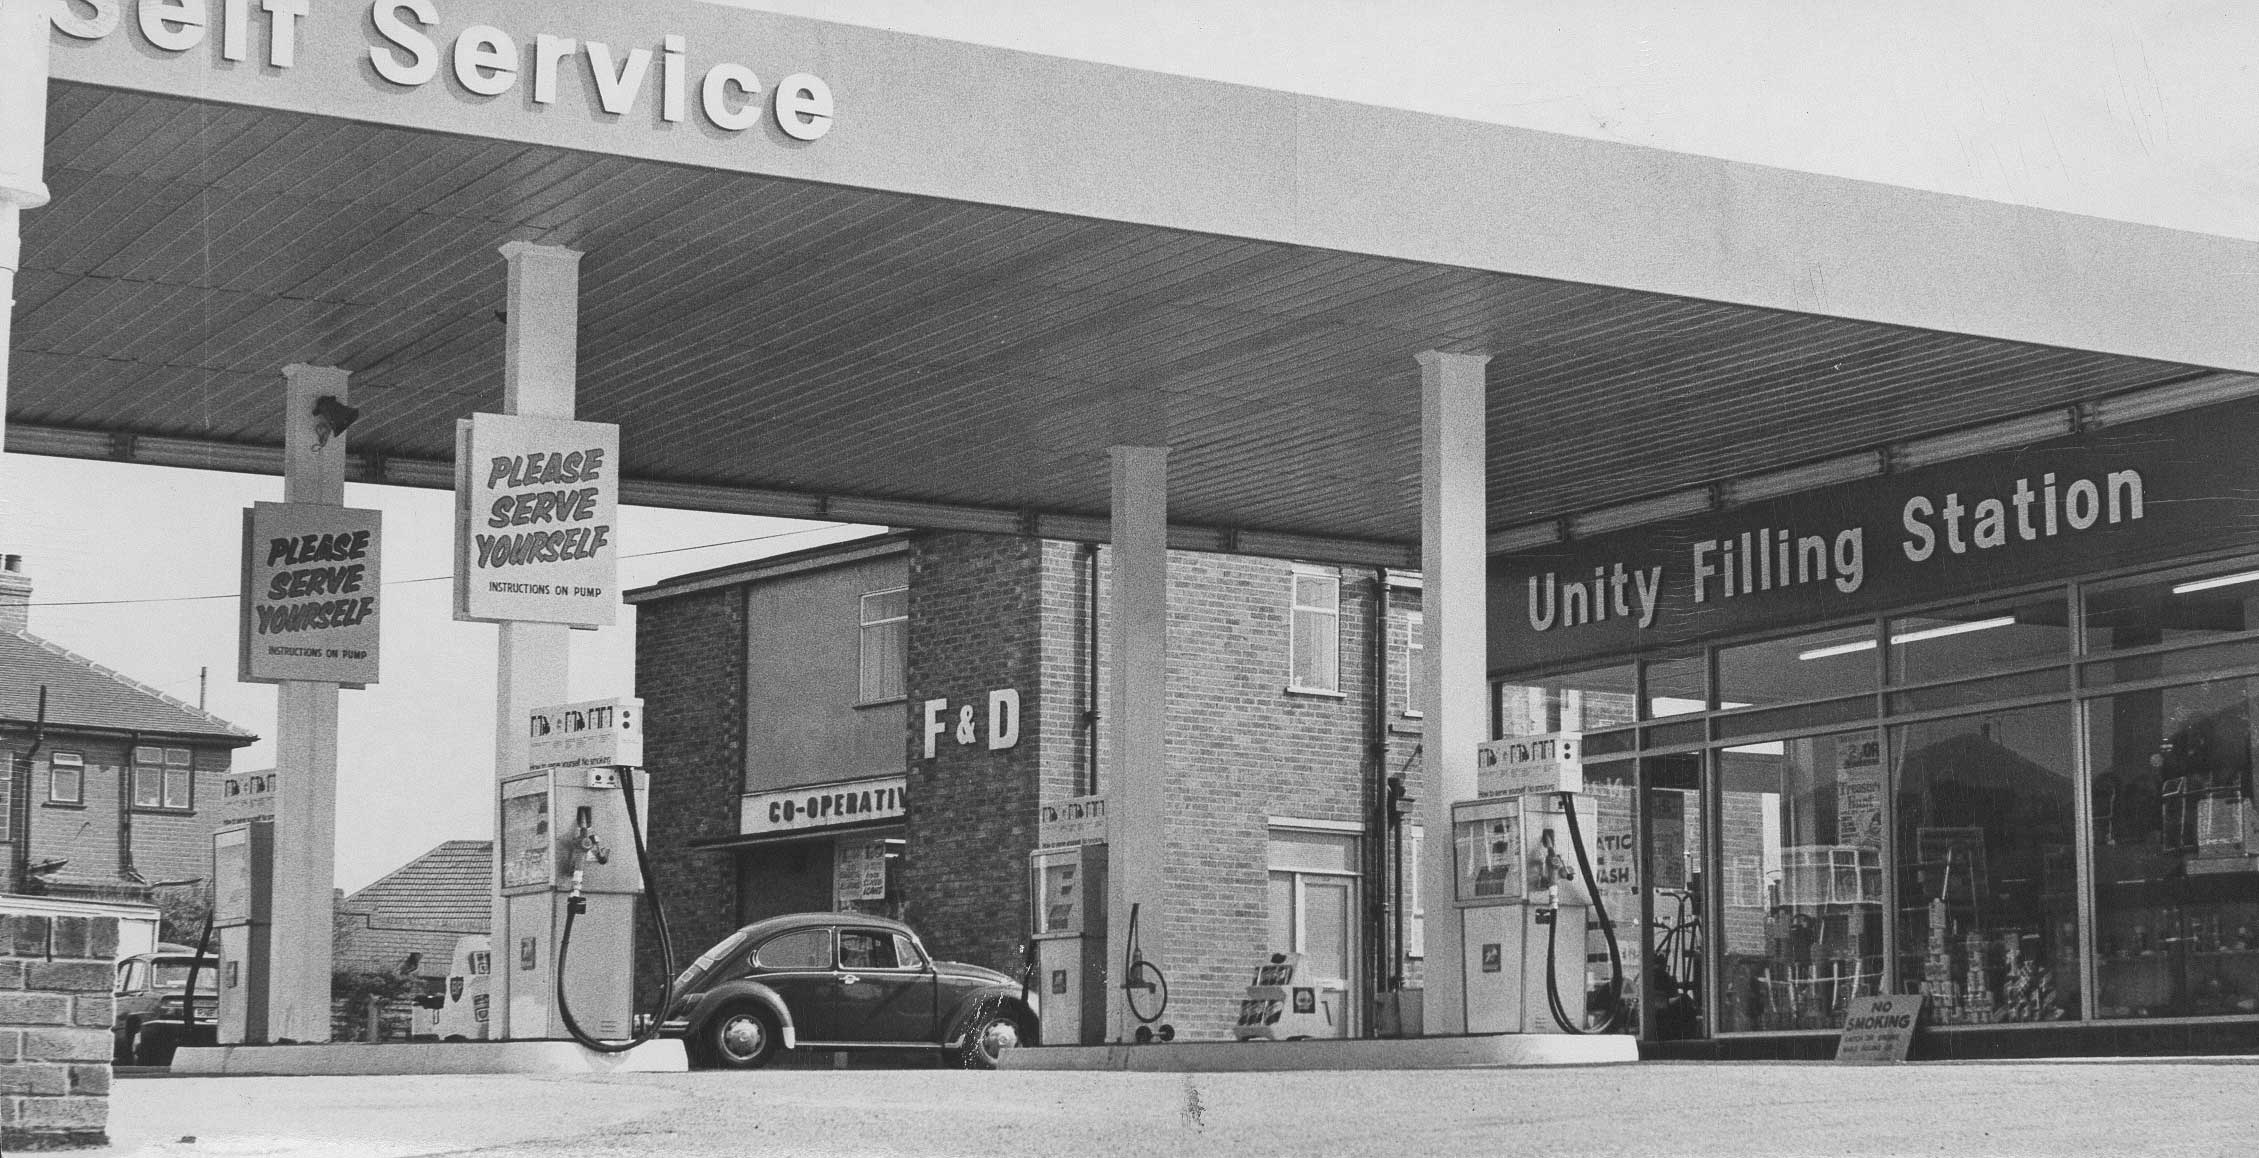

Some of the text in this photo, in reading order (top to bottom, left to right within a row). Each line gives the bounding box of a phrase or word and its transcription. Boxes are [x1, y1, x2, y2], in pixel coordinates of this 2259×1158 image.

[369, 0, 834, 141] Service
[487, 448, 604, 490] PLEASE
[488, 488, 599, 528] SERVE
[267, 530, 371, 566] PLEASE
[475, 525, 609, 569] YOURSELF
[1529, 469, 2144, 632] Unity Filling Station
[268, 564, 364, 600] SERVE
[489, 581, 602, 598] INSTRUCTIONS ON PUMP
[256, 597, 374, 634] YOURSELF
[268, 646, 368, 660] INSTRUCTIONS ON PUMP
[923, 688, 1020, 759] F & D
[1597, 867, 1629, 883] ASH
[1846, 1015, 1910, 1031] SMOKING
[1872, 1001, 1892, 1012] NO
